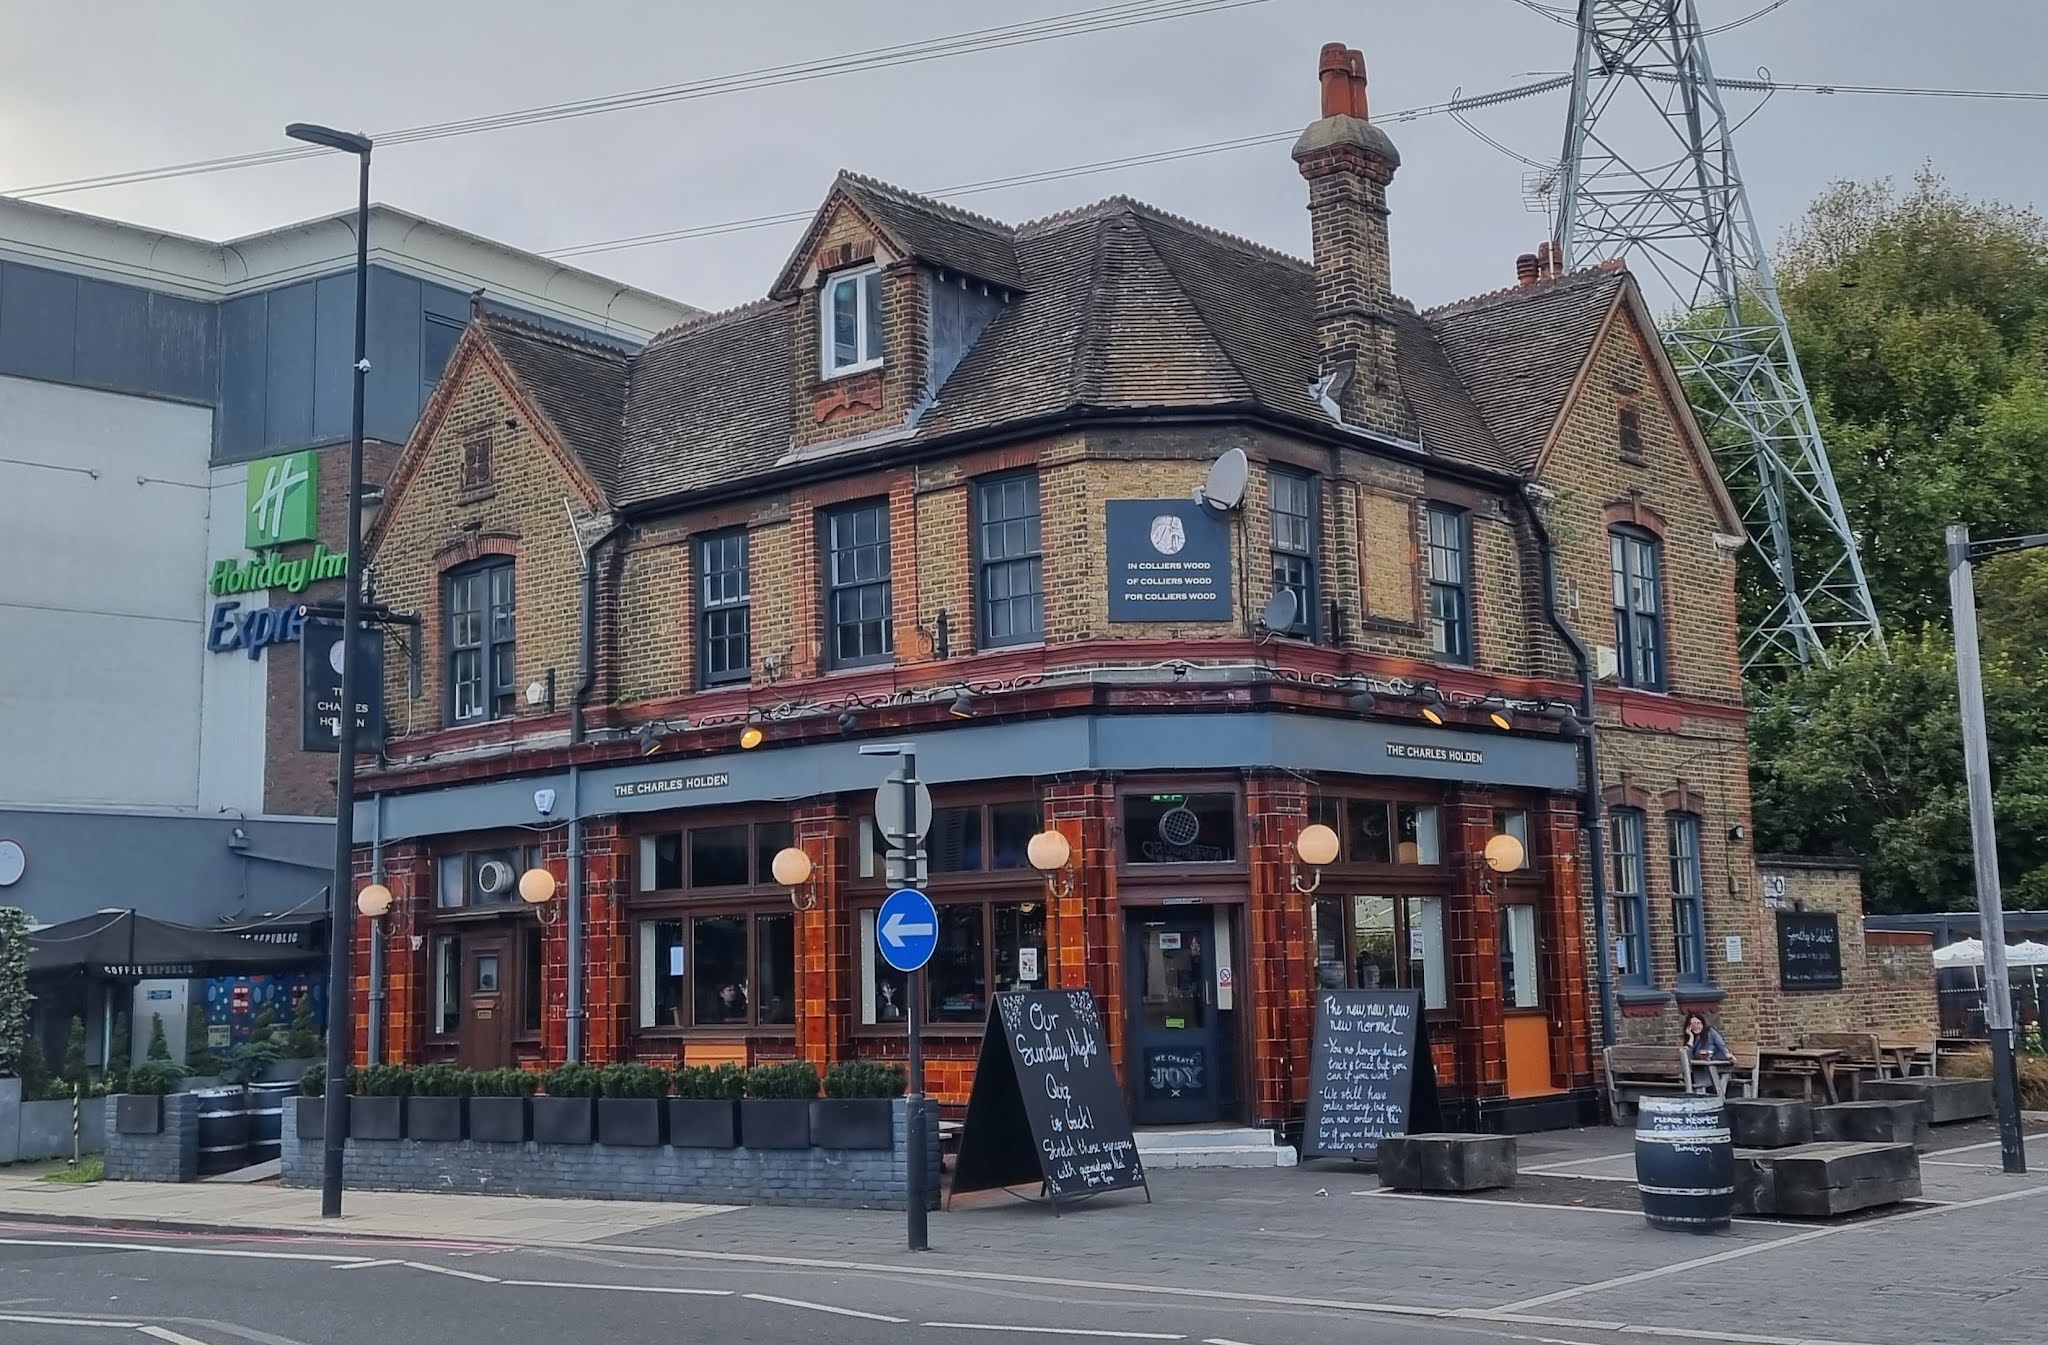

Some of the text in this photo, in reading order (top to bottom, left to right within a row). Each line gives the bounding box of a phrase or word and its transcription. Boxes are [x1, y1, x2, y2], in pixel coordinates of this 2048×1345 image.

[208, 552, 309, 597] Holiday
[1128, 562, 1211, 570] IN COLLIERS WOOD
[1126, 577, 1212, 585] OF COLLIERS WOOD
[1125, 593, 1216, 601] FOR COLLIERS WOOD
[207, 601, 311, 662] Expre
[317, 701, 369, 713] CHAES
[1386, 744, 1483, 764] THE CHARLES HOLDEN
[614, 774, 729, 797] THE CHARLES HOLDEN
[1323, 995, 1343, 1015] The
[1029, 1002, 1059, 1031] Our
[1329, 1017, 1404, 1035] new normal
[1015, 1027, 1097, 1072] Sunday Night
[1344, 1046, 1354, 1054] no
[1355, 1040, 1380, 1062] longer
[1398, 1044, 1408, 1057] to
[1328, 1056, 1347, 1070] track
[1376, 1056, 1390, 1070] but
[1392, 1063, 1408, 1076] you
[1150, 1066, 1204, 1089] JOY
[1326, 1072, 1342, 1081] can
[1344, 1070, 1352, 1083] if
[1353, 1072, 1369, 1084] you
[1045, 1073, 1072, 1108] Quiz
[1341, 1085, 1362, 1100] still
[1367, 1085, 1387, 1100] have
[1050, 1105, 1095, 1132] is back!
[1653, 1115, 1719, 1124] PLEASE RESPECT
[1057, 1160, 1077, 1180] with
